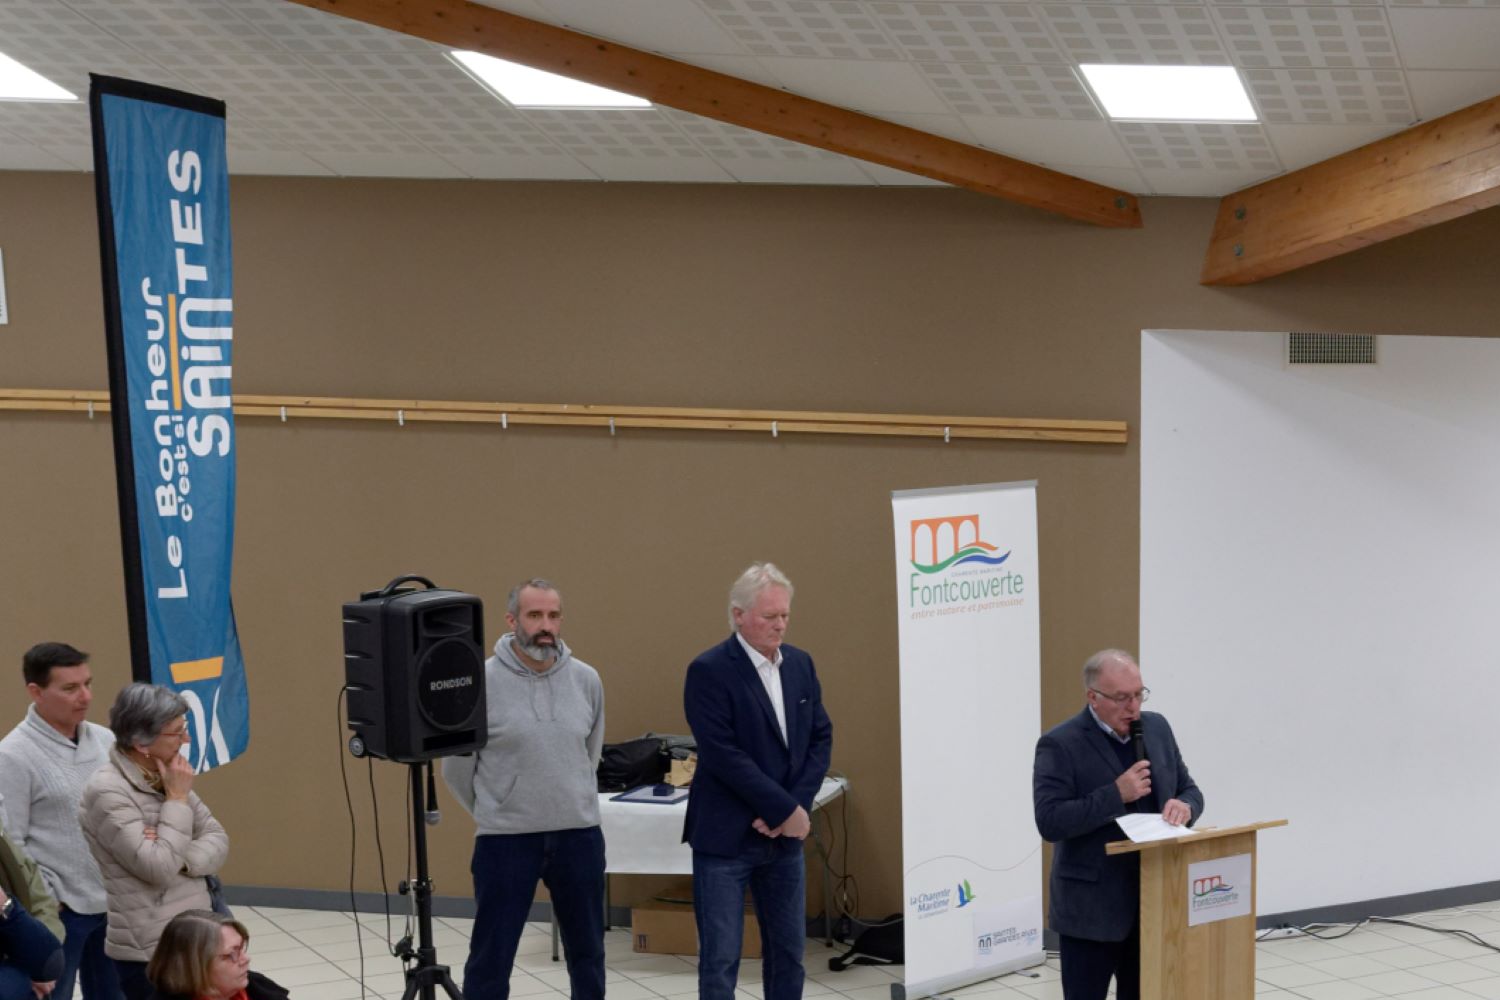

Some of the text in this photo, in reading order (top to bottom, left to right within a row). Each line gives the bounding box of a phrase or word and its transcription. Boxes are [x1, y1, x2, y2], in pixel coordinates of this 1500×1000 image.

[141, 276, 189, 599] Le Bonheur
[171, 414, 186, 439] si
[910, 570, 1024, 608] Fontcouverte
[937, 604, 966, 617] nature
[430, 676, 473, 691] RONDSON
